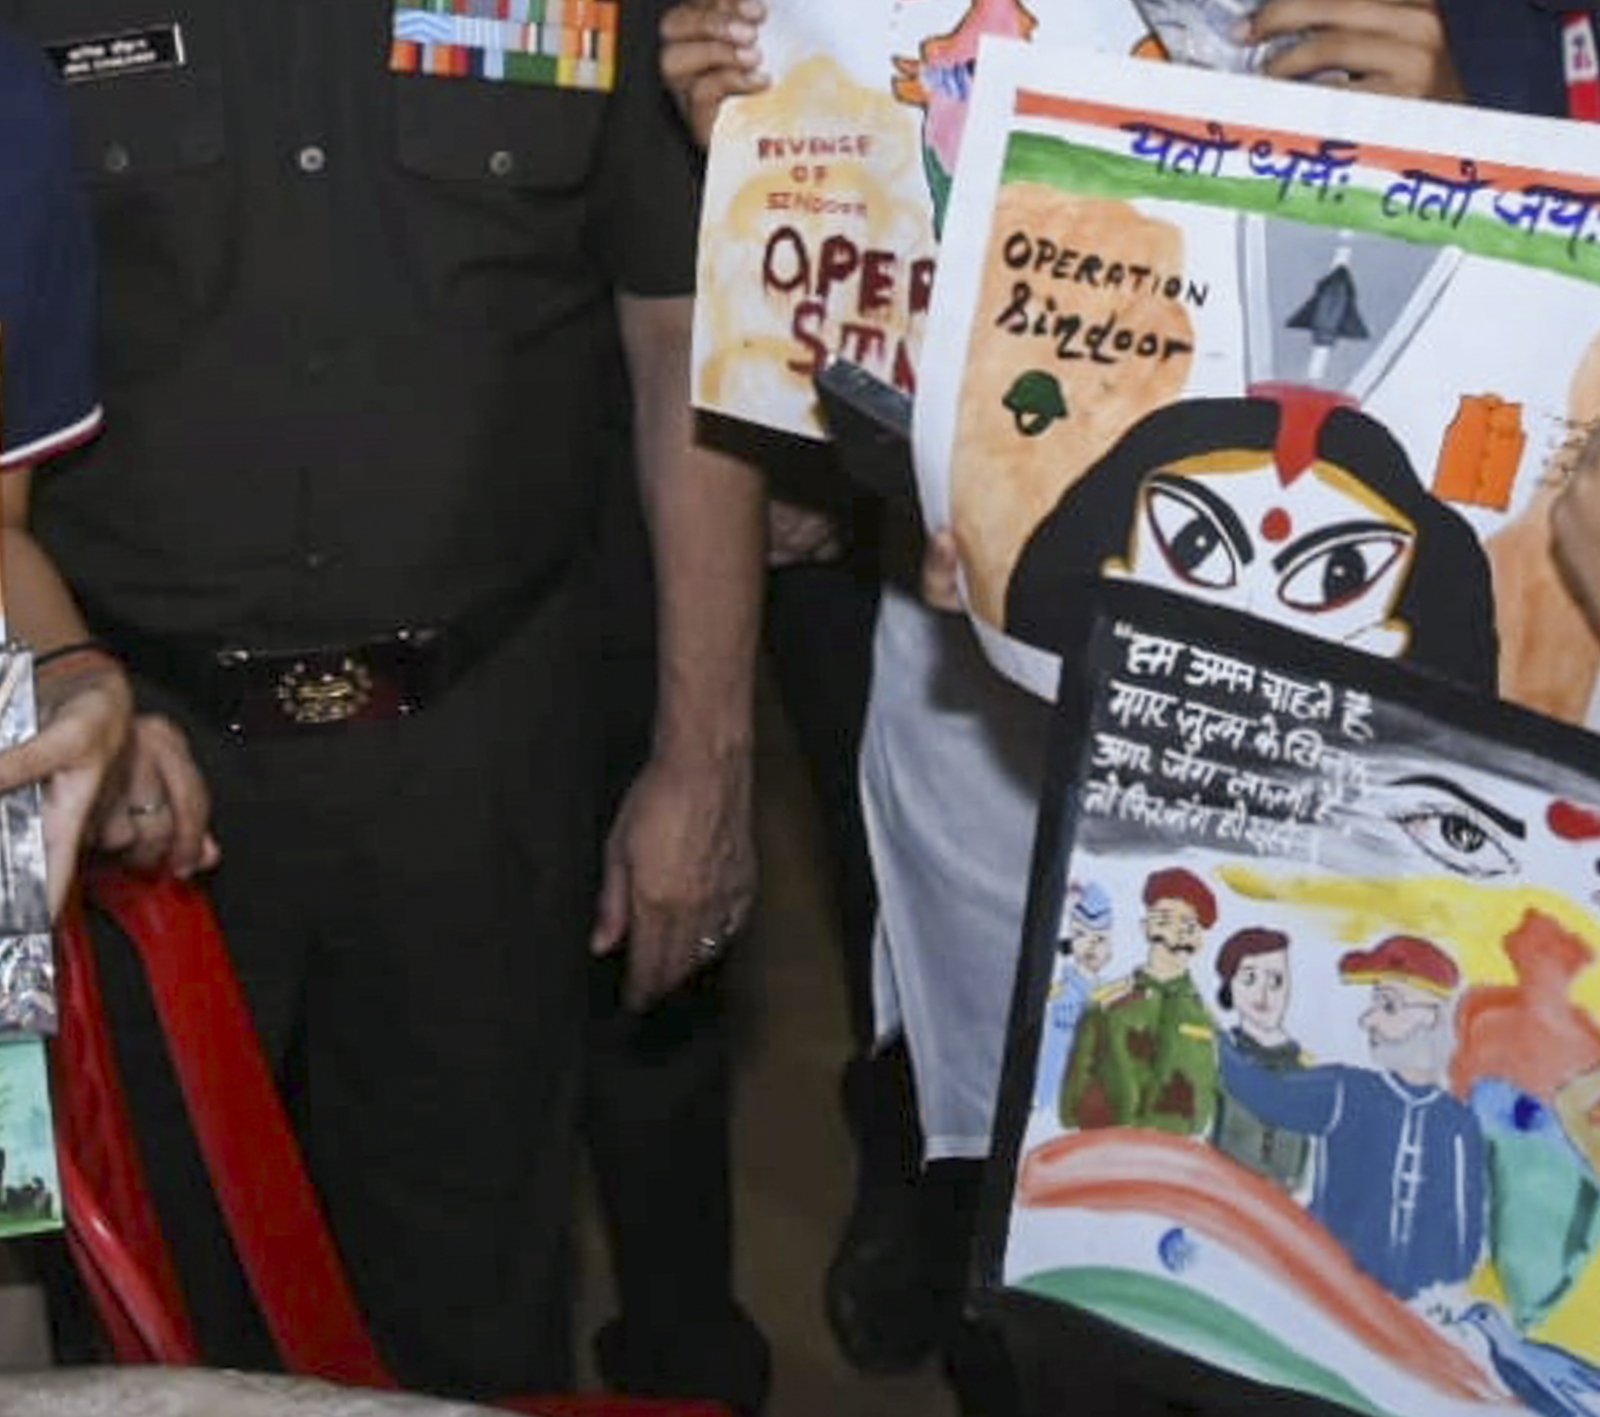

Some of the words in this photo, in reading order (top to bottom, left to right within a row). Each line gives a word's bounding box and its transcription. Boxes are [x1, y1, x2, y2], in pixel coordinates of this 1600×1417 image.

[789, 164, 829, 185] OF
[1002, 231, 1209, 307] OPERATION
[1109, 679, 1179, 728] मगर
